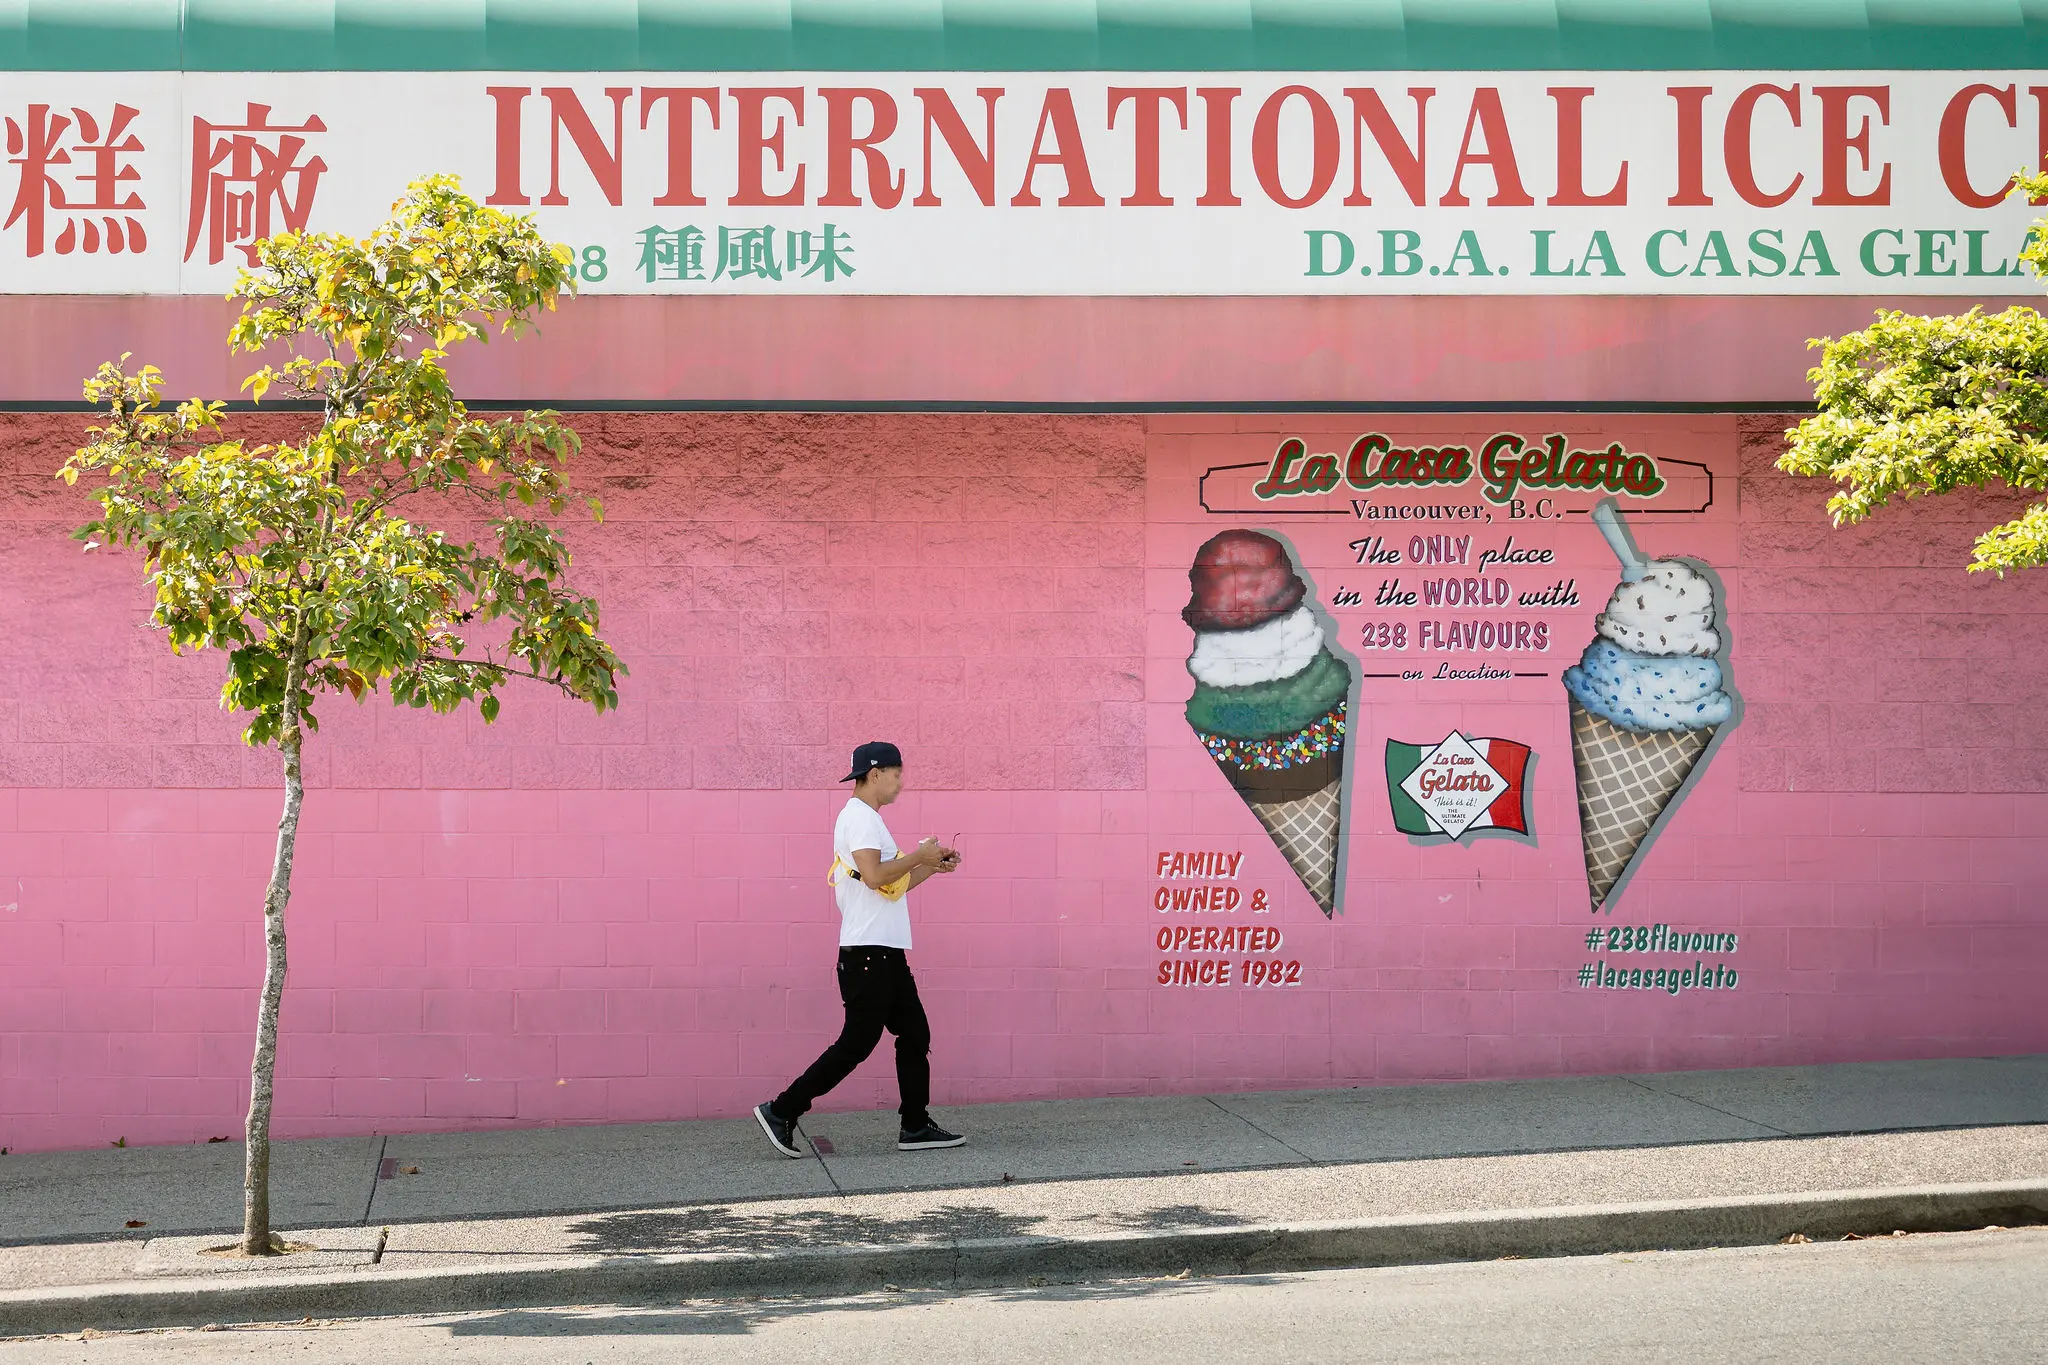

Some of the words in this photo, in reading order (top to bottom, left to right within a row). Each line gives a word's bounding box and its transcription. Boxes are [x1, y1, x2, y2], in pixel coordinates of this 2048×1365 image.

[485, 84, 1628, 209] INTERNATIONAL
[1666, 82, 1892, 209] ICE
[1938, 83, 2048, 209] C
[3, 102, 328, 268] 糕廠
[635, 223, 857, 283] 種風味
[1303, 229, 1510, 277] D.B.A.
[1529, 229, 1626, 277] LA
[1645, 228, 1841, 277] CASA
[1252, 437, 1343, 501] La
[1345, 432, 1474, 489] Casa
[1479, 431, 1668, 507] Gelato
[1350, 499, 1493, 524] Vancouver,
[1508, 498, 1563, 520] B.C.
[1348, 536, 1403, 565] The
[1407, 534, 1473, 566] ONLY
[1477, 535, 1556, 574] place
[1332, 585, 1364, 608] in
[1374, 578, 1420, 608] the
[1423, 577, 1515, 609] WORLD
[1517, 578, 1582, 608] with
[1361, 622, 1410, 651] 238
[1419, 620, 1552, 653] FLAVOURS
[1402, 668, 1425, 681] on
[1432, 661, 1513, 682] Location
[1432, 753, 1449, 765] La
[1450, 753, 1475, 765] Casa
[1419, 768, 1494, 799] Gelato
[1434, 796, 1454, 807] This
[1456, 797, 1464, 806] is
[1465, 798, 1478, 807] it!
[1156, 851, 1244, 880] FAMILY
[1154, 886, 1242, 913] OWNED
[1250, 888, 1269, 913] &
[1156, 926, 1283, 953] OPERATED
[1585, 923, 1738, 953] #238flavours
[1157, 960, 1232, 987] SINCE
[1241, 960, 1303, 988] 1982
[1577, 960, 1738, 996] #lacasagelato
